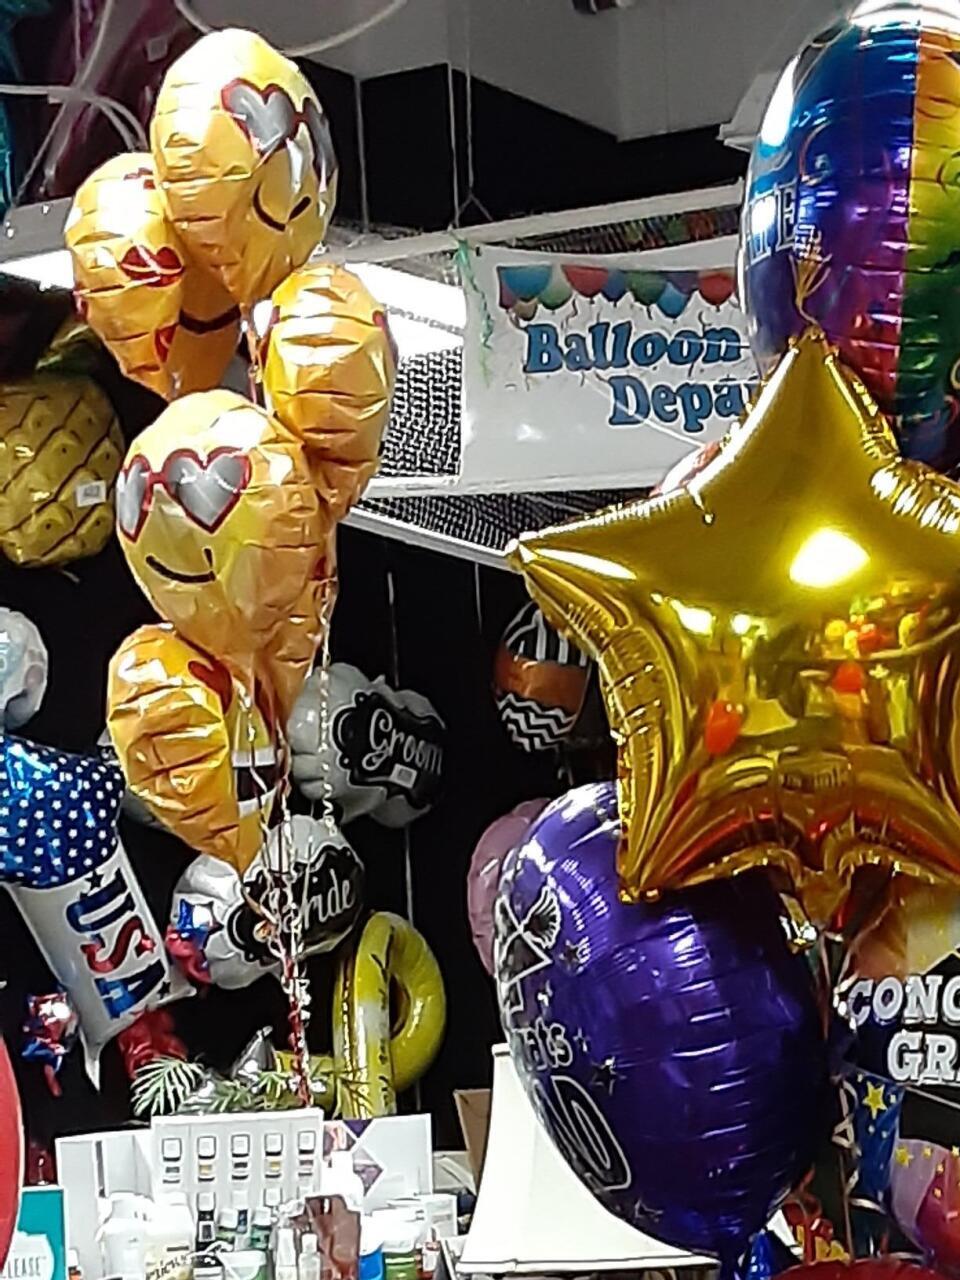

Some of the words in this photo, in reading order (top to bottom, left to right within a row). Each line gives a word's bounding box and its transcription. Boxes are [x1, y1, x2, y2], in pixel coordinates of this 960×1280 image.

[523, 320, 742, 374] Balloon
[608, 374, 760, 433] Depa
[362, 708, 442, 776] Groom
[66, 868, 166, 1020] USA
